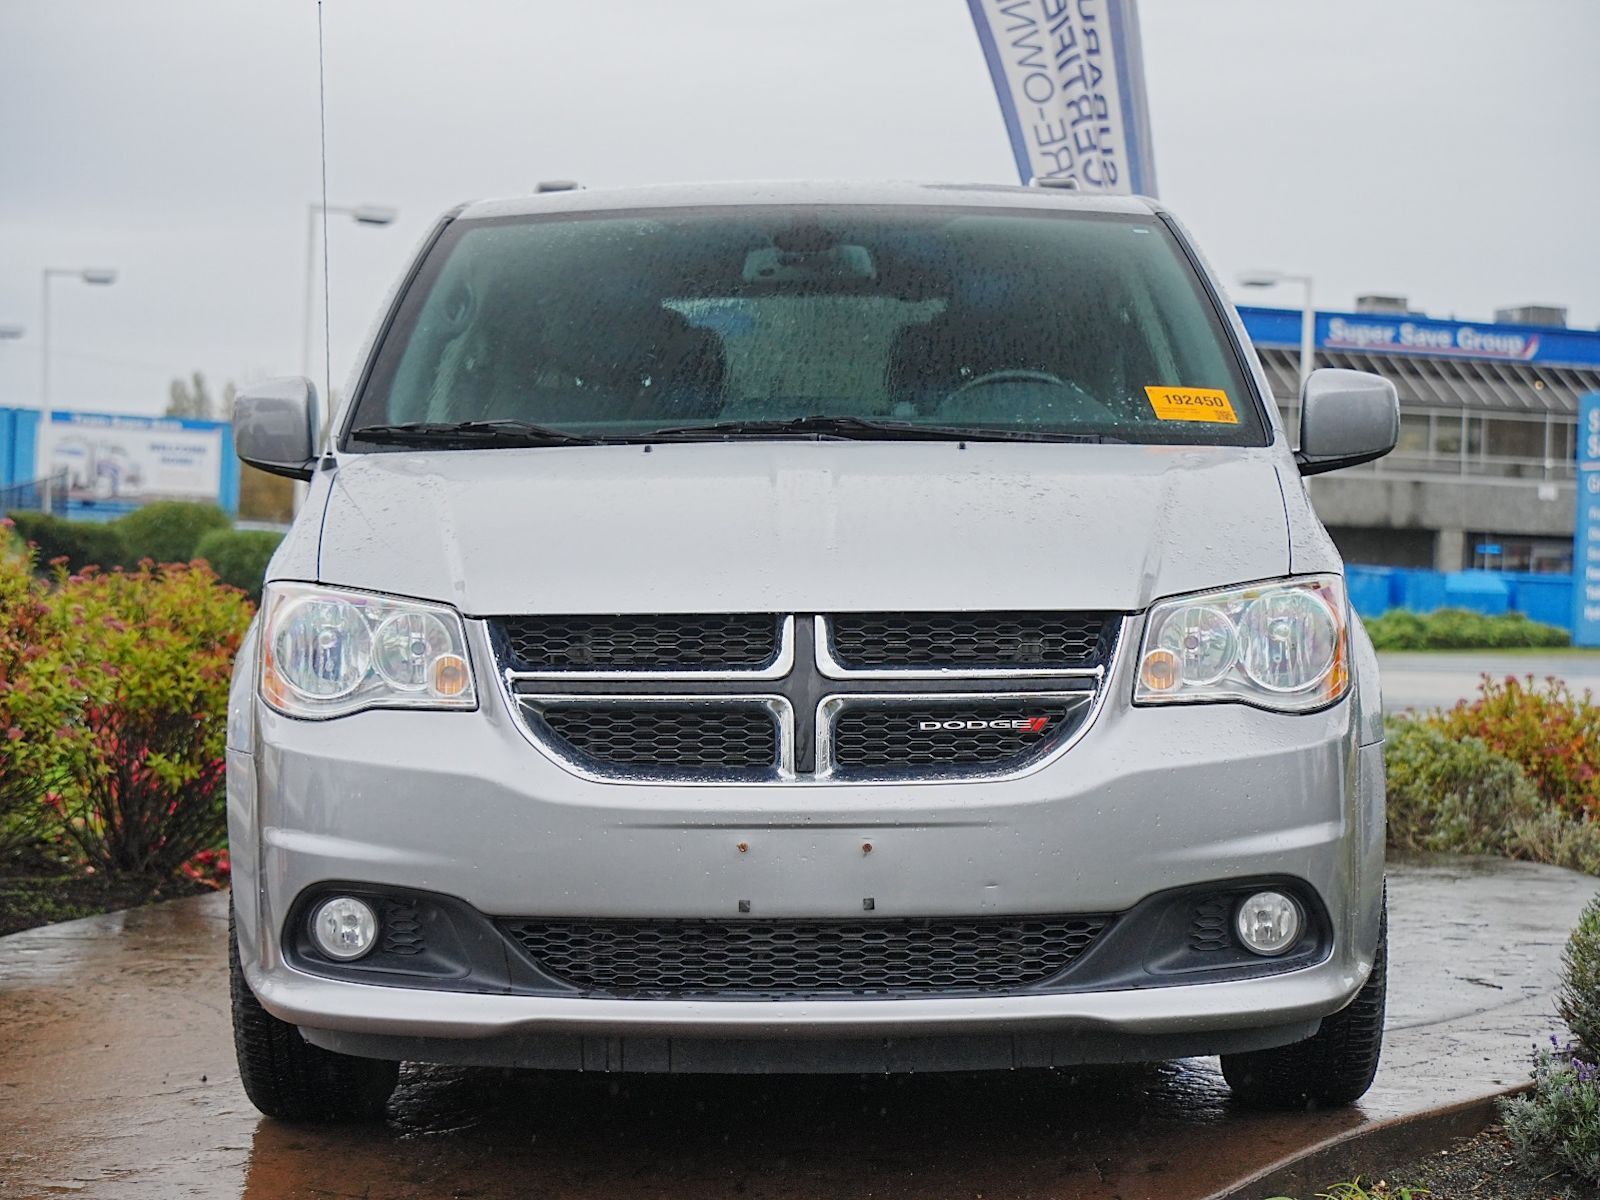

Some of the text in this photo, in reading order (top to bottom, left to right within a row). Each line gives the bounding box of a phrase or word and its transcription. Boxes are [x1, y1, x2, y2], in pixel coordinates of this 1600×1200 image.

[1329, 317, 1524, 357] Super Save Group
[1163, 394, 1224, 408] 192450
[919, 719, 1031, 731] DODGE
